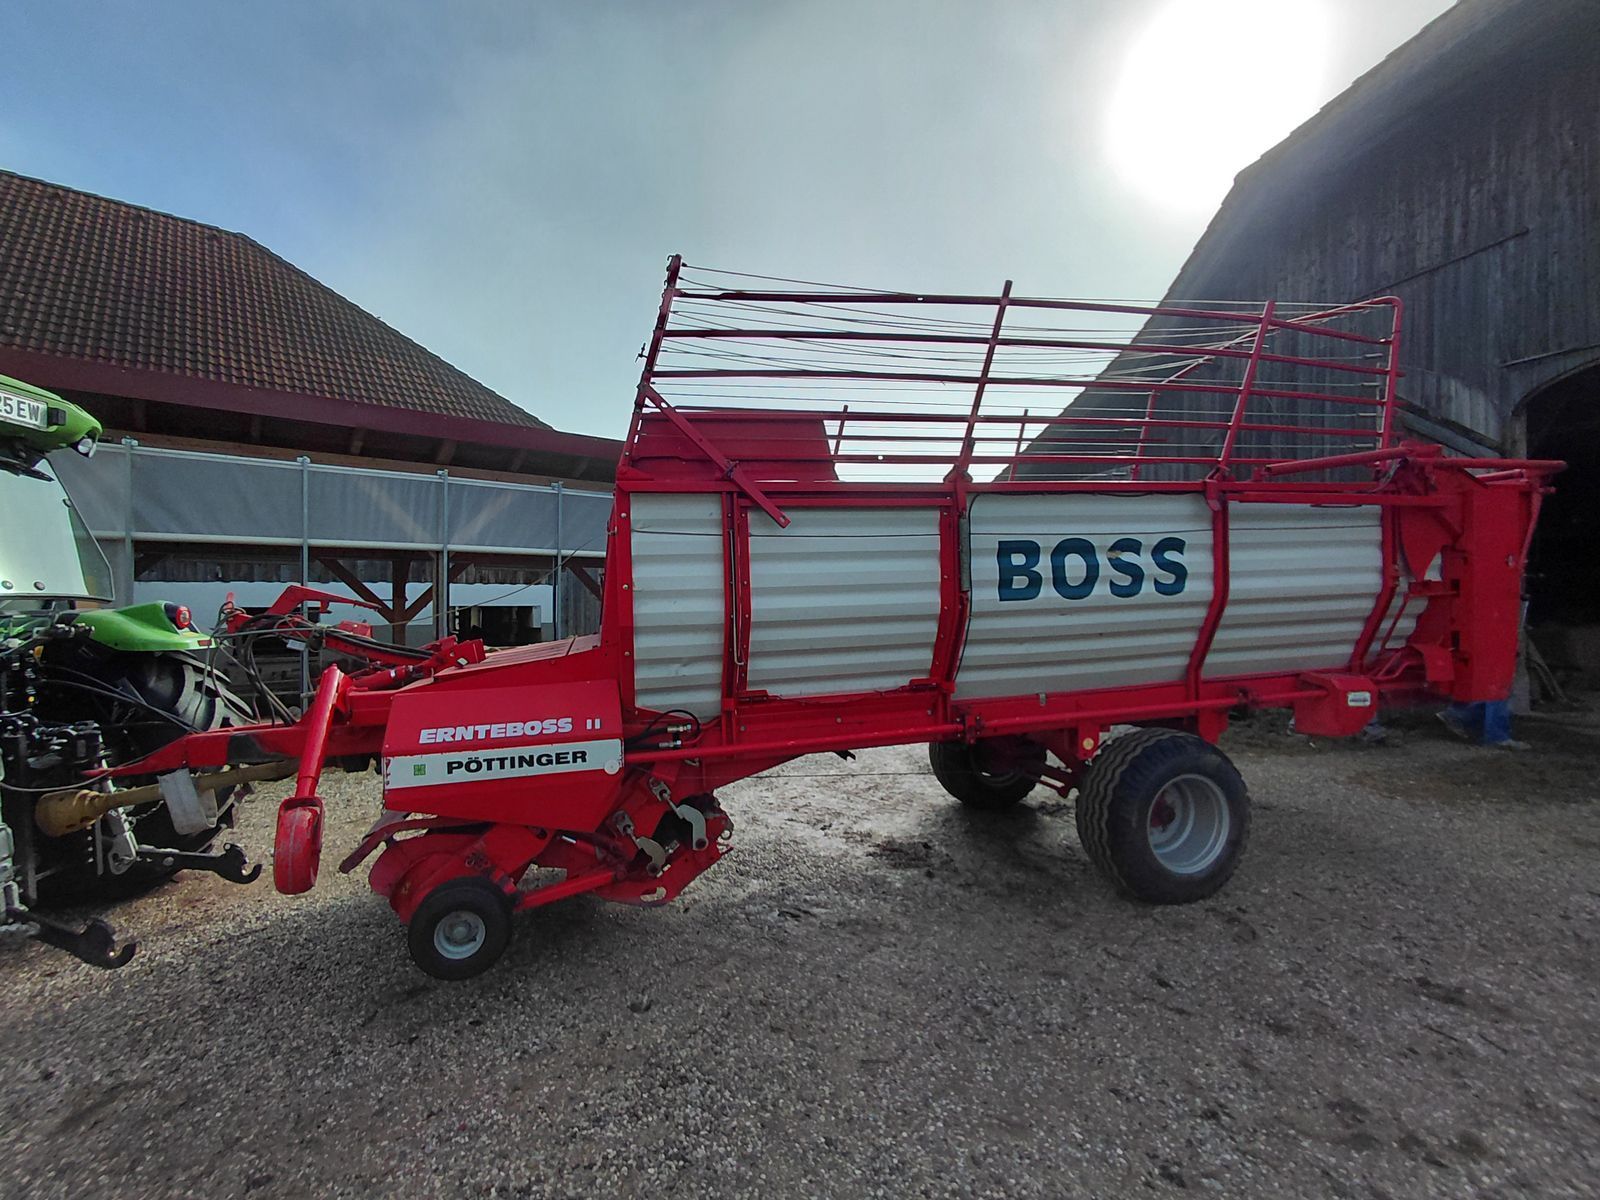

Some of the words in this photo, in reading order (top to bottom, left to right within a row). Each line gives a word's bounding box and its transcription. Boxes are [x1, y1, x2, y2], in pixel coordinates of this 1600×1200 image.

[997, 537, 1188, 601] BOSS
[418, 717, 573, 744] ERNTEBOSS
[447, 750, 588, 775] PÖTTINGER
